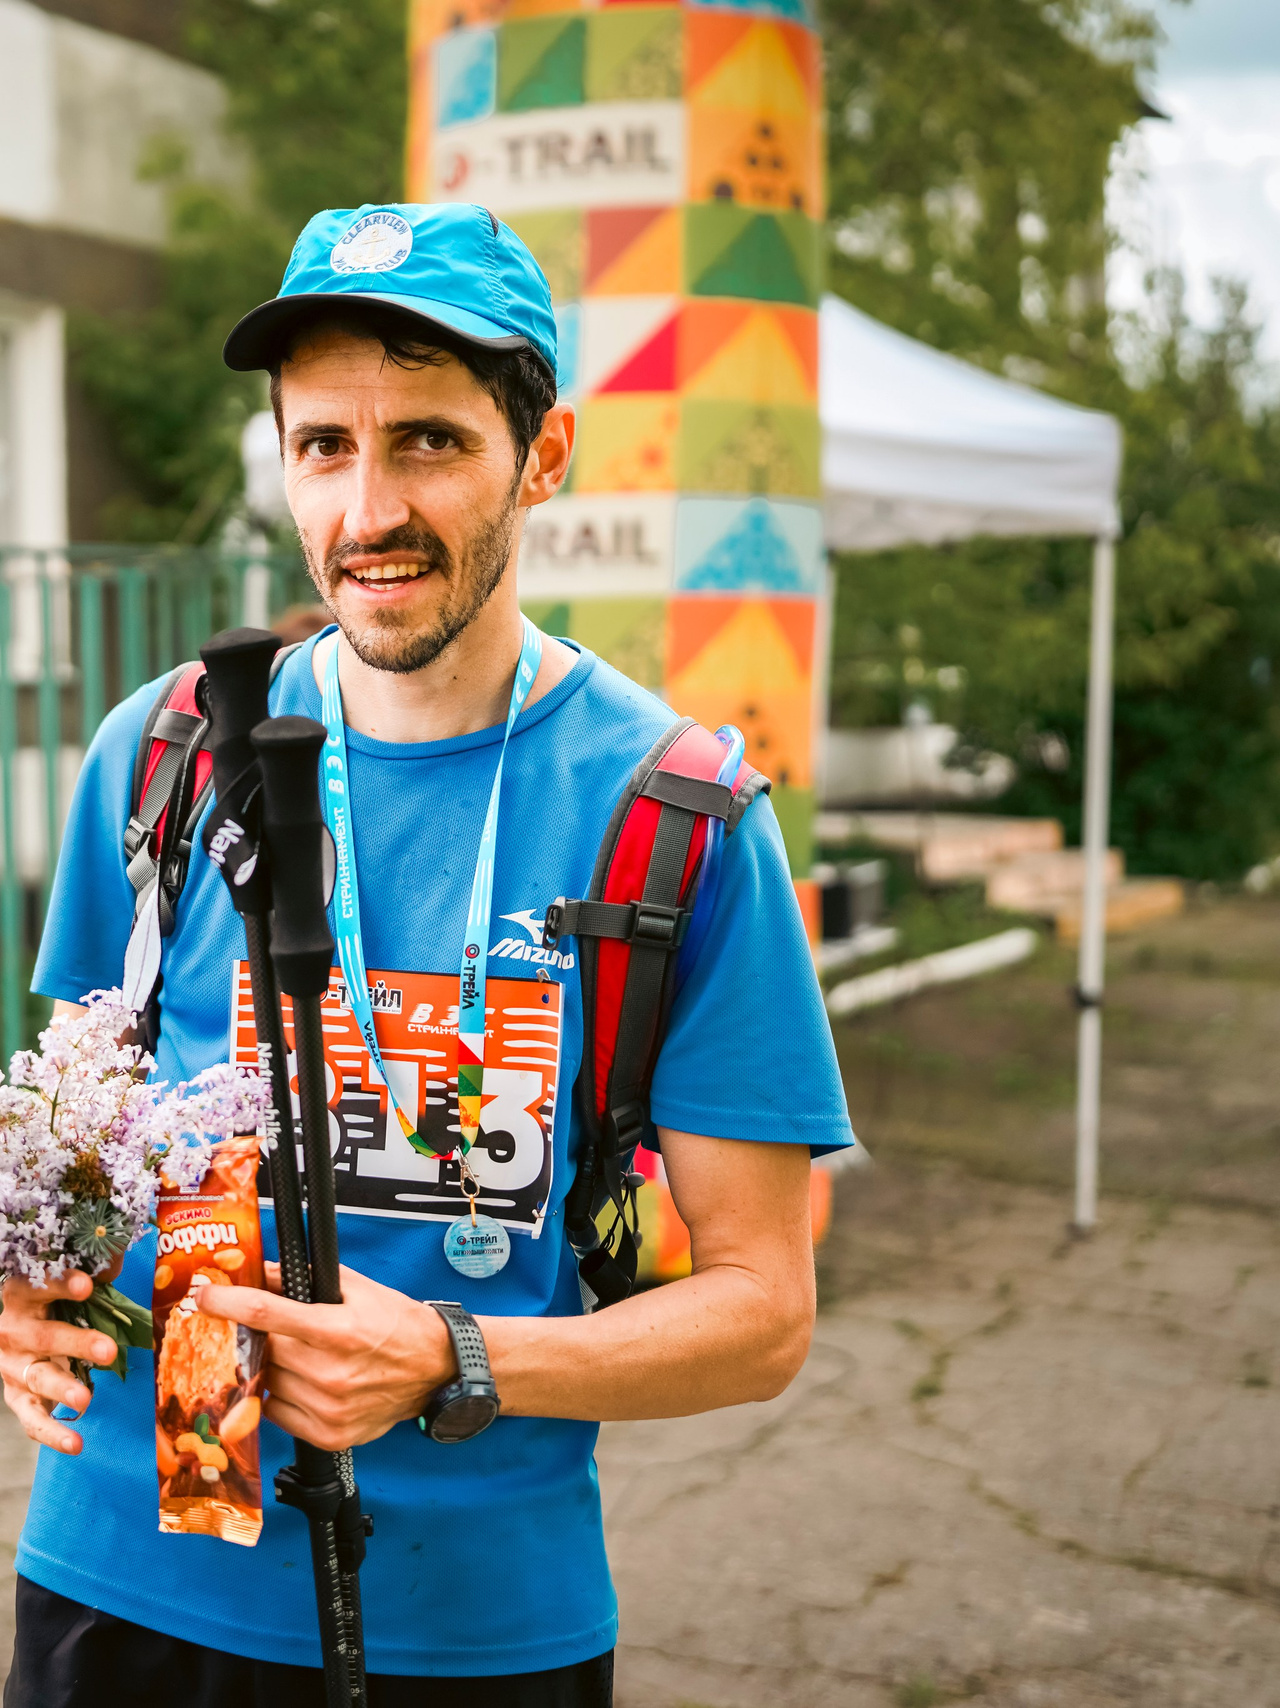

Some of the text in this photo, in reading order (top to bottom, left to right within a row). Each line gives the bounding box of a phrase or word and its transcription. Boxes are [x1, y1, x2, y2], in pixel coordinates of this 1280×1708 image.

[341, 213, 409, 246] CLEARVIEW
[374, 248, 408, 272] CLUB
[209, 818, 246, 869] Nat
[164, 1206, 213, 1226] ЭСКИМО
